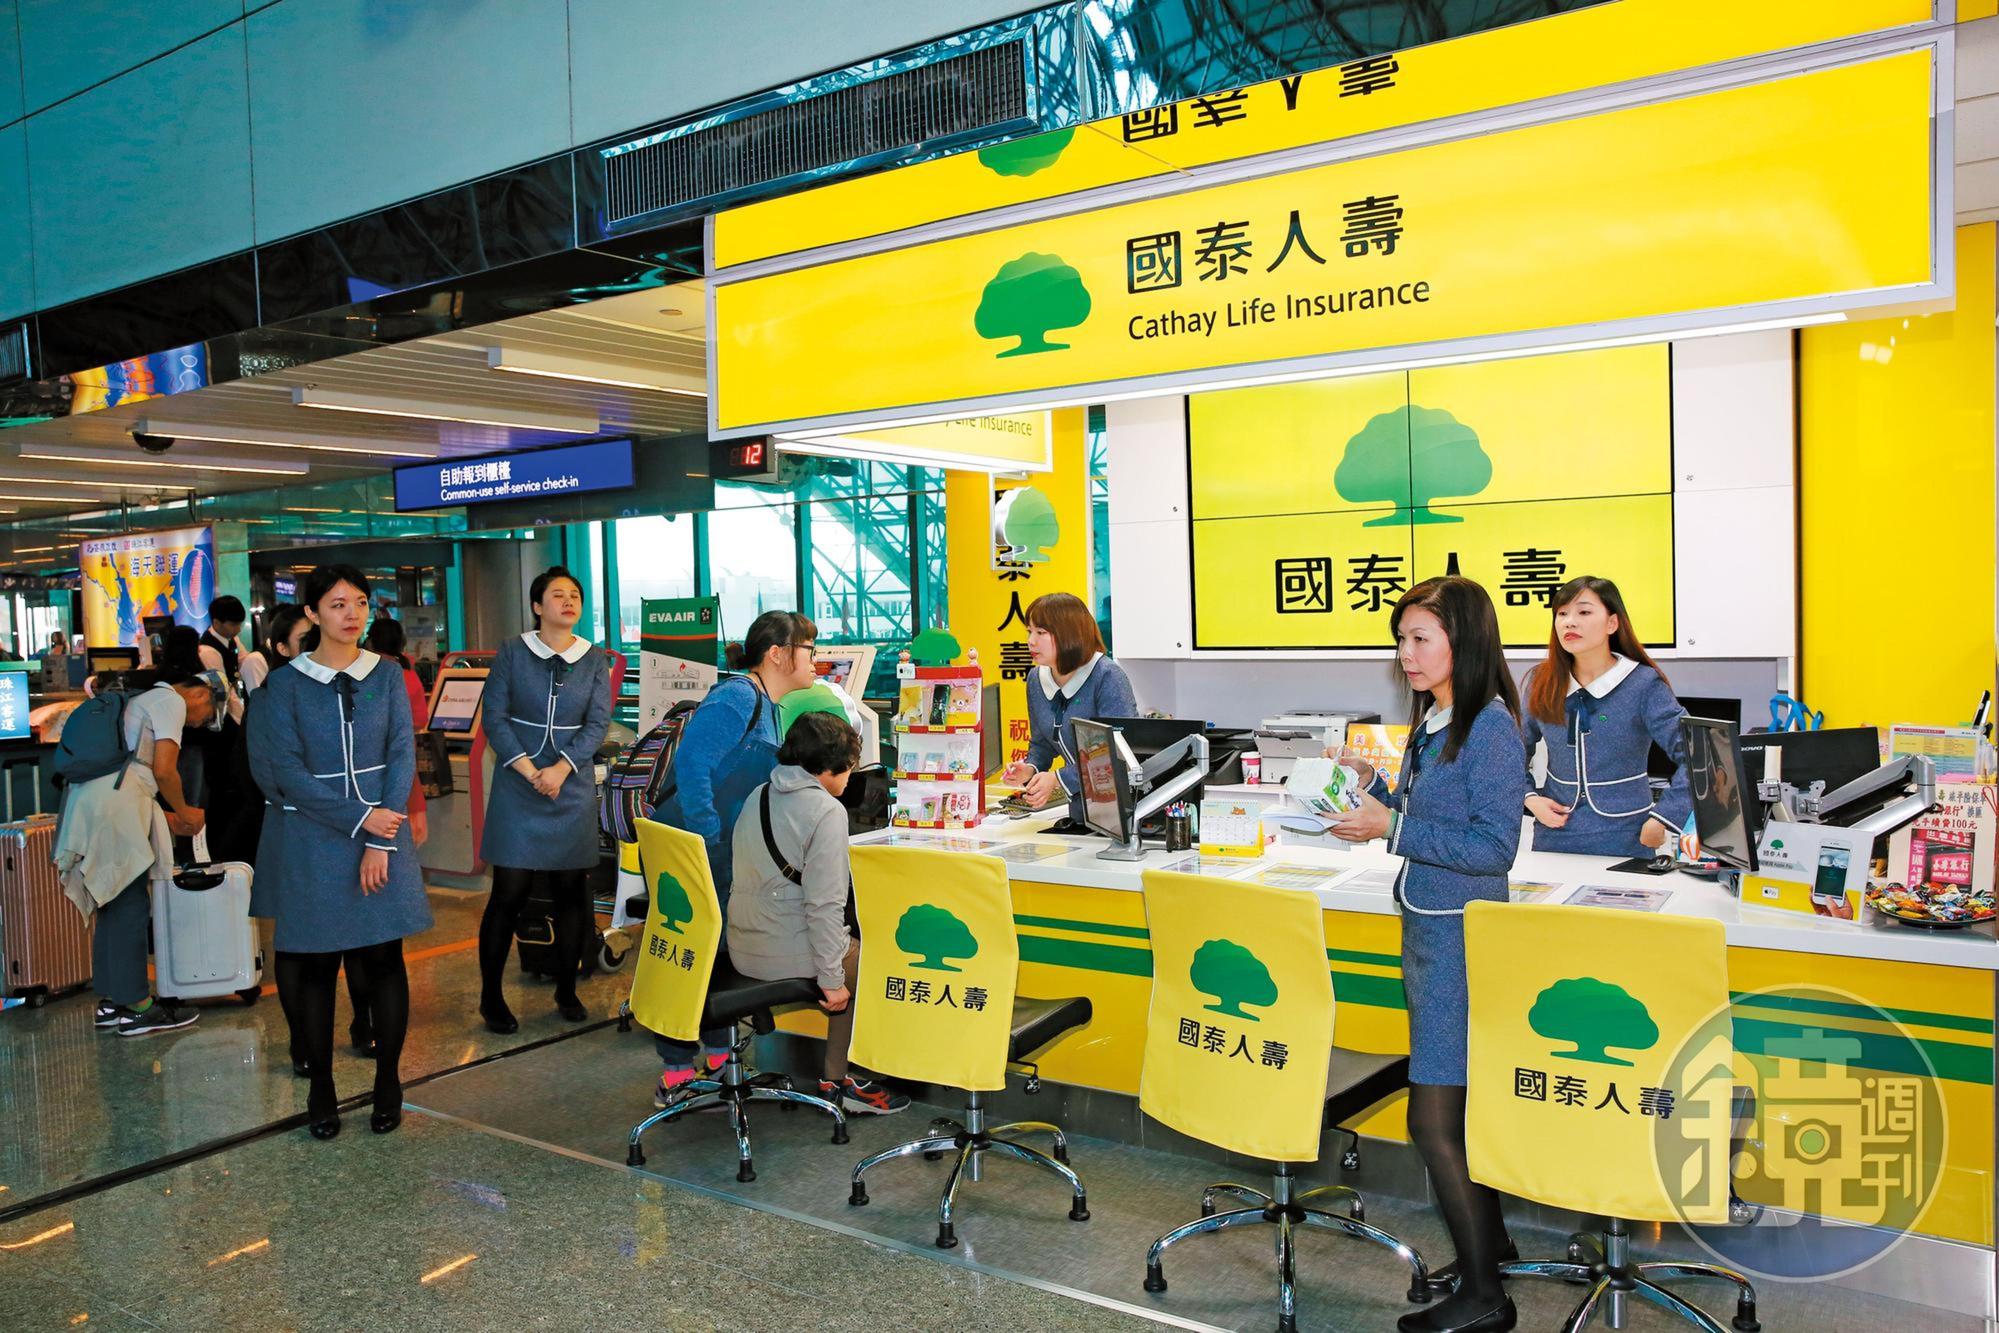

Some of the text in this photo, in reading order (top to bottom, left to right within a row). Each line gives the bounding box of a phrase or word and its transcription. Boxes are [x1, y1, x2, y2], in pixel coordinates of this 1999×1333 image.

[1126, 194, 1404, 294] 國泰人壽
[1128, 279, 1430, 341] Cathay Life Insurance
[744, 444, 761, 465] 12
[440, 475, 579, 501] Common-use self-service check-in
[649, 611, 696, 623] EVA AIR
[649, 934, 695, 971] 國泰人壽
[885, 976, 987, 1012] 國泰人壽
[1178, 1017, 1288, 1070] 國泰人壽
[1515, 1067, 1675, 1119] 國泰人壽
